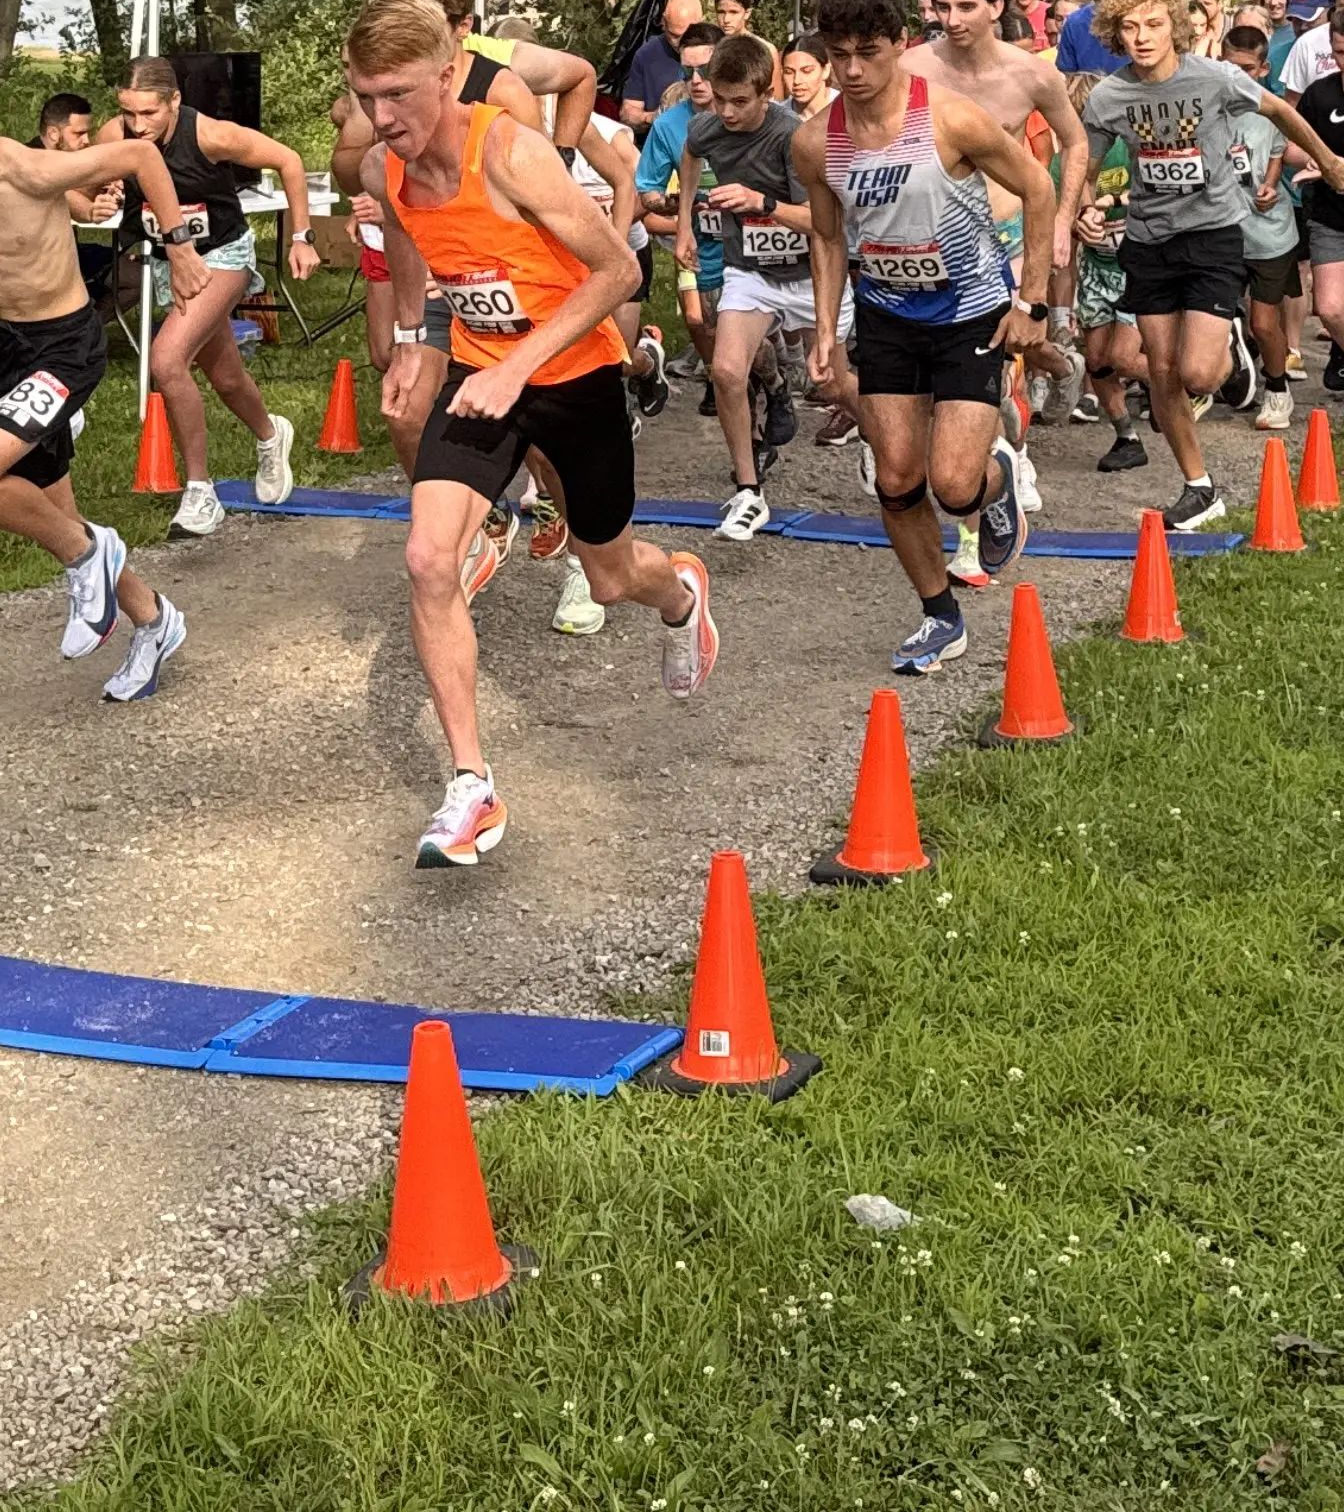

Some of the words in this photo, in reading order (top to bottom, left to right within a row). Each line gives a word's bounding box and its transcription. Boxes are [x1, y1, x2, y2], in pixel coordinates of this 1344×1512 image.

[848, 163, 913, 191] TEAM
[1142, 162, 1200, 181] 1362
[856, 186, 900, 208] USA
[747, 230, 805, 253] 1262
[872, 257, 941, 279] 1269
[443, 289, 515, 316] 1260
